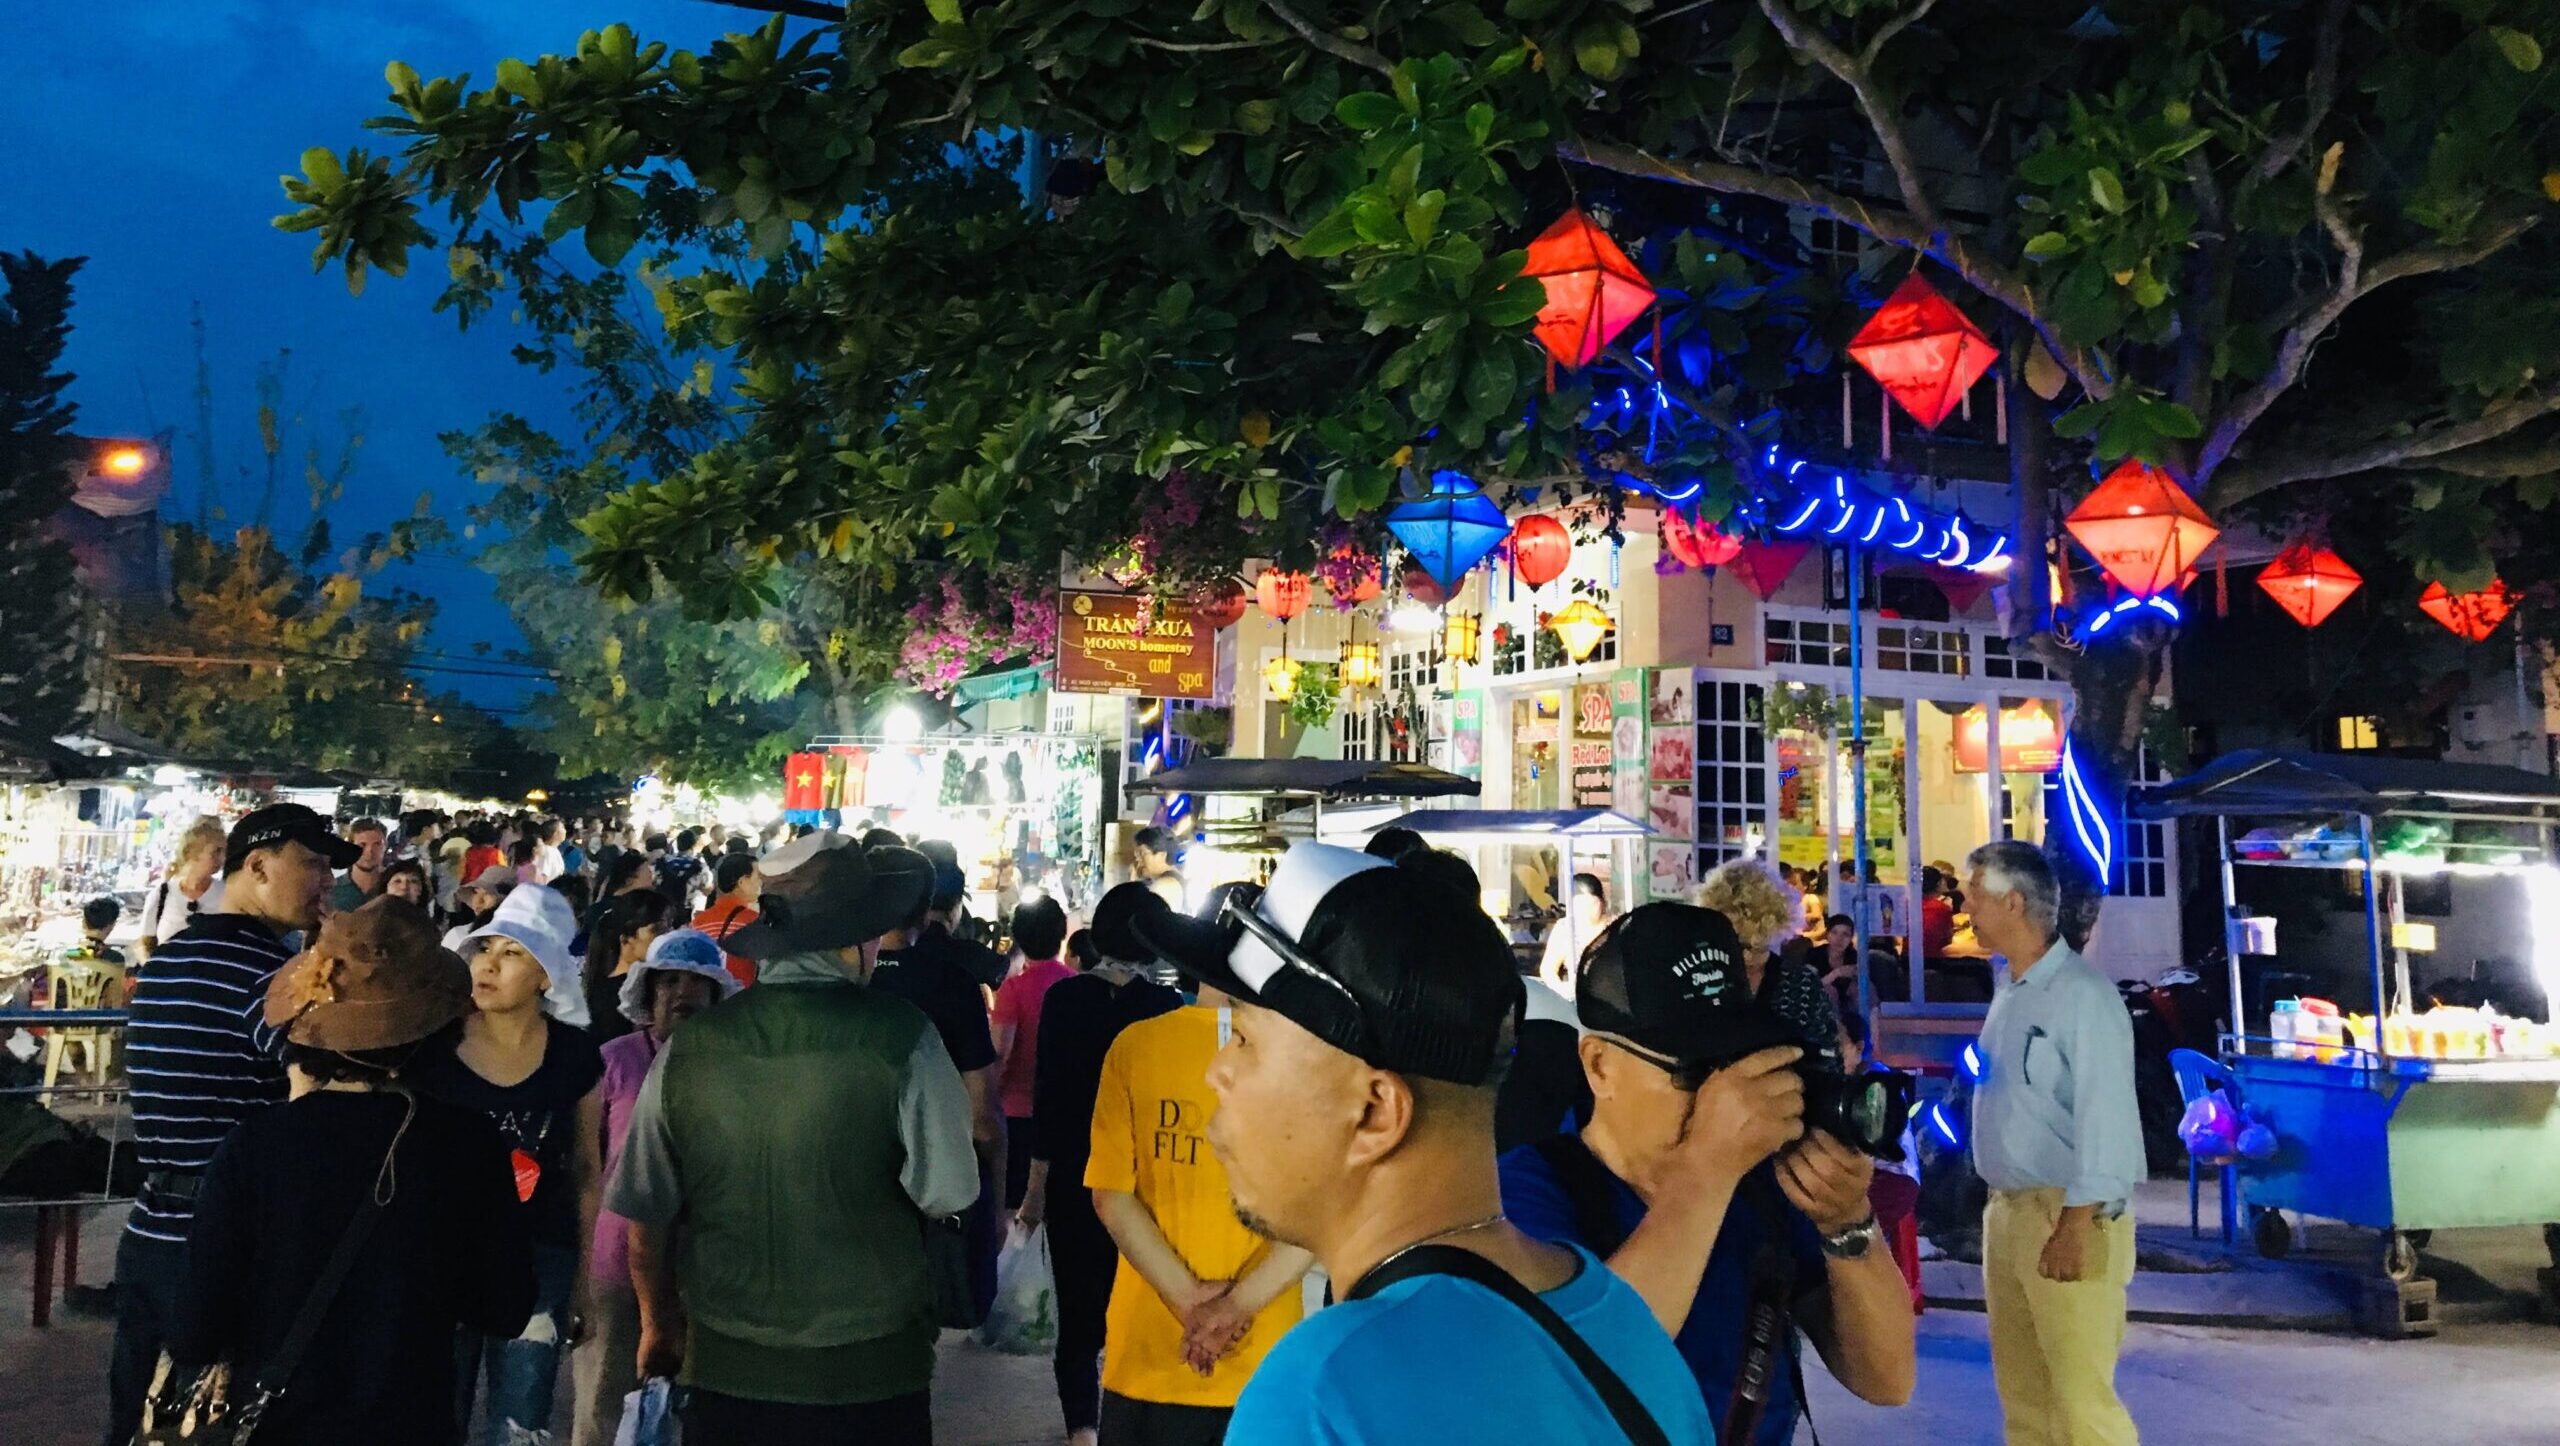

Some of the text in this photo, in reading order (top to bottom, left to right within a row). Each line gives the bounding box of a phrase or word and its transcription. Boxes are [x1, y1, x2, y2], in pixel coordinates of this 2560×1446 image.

[1083, 612, 1194, 637] TRĂN XƯA
[1083, 637, 1193, 655] MOON'S homestay
[1149, 655, 1171, 674] and
[1178, 671, 1203, 693] spa
[1457, 700, 1476, 717] SPA
[1582, 694, 1612, 729] SPA
[1572, 746, 1591, 764] Red
[1154, 1131, 1204, 1165] FLT
